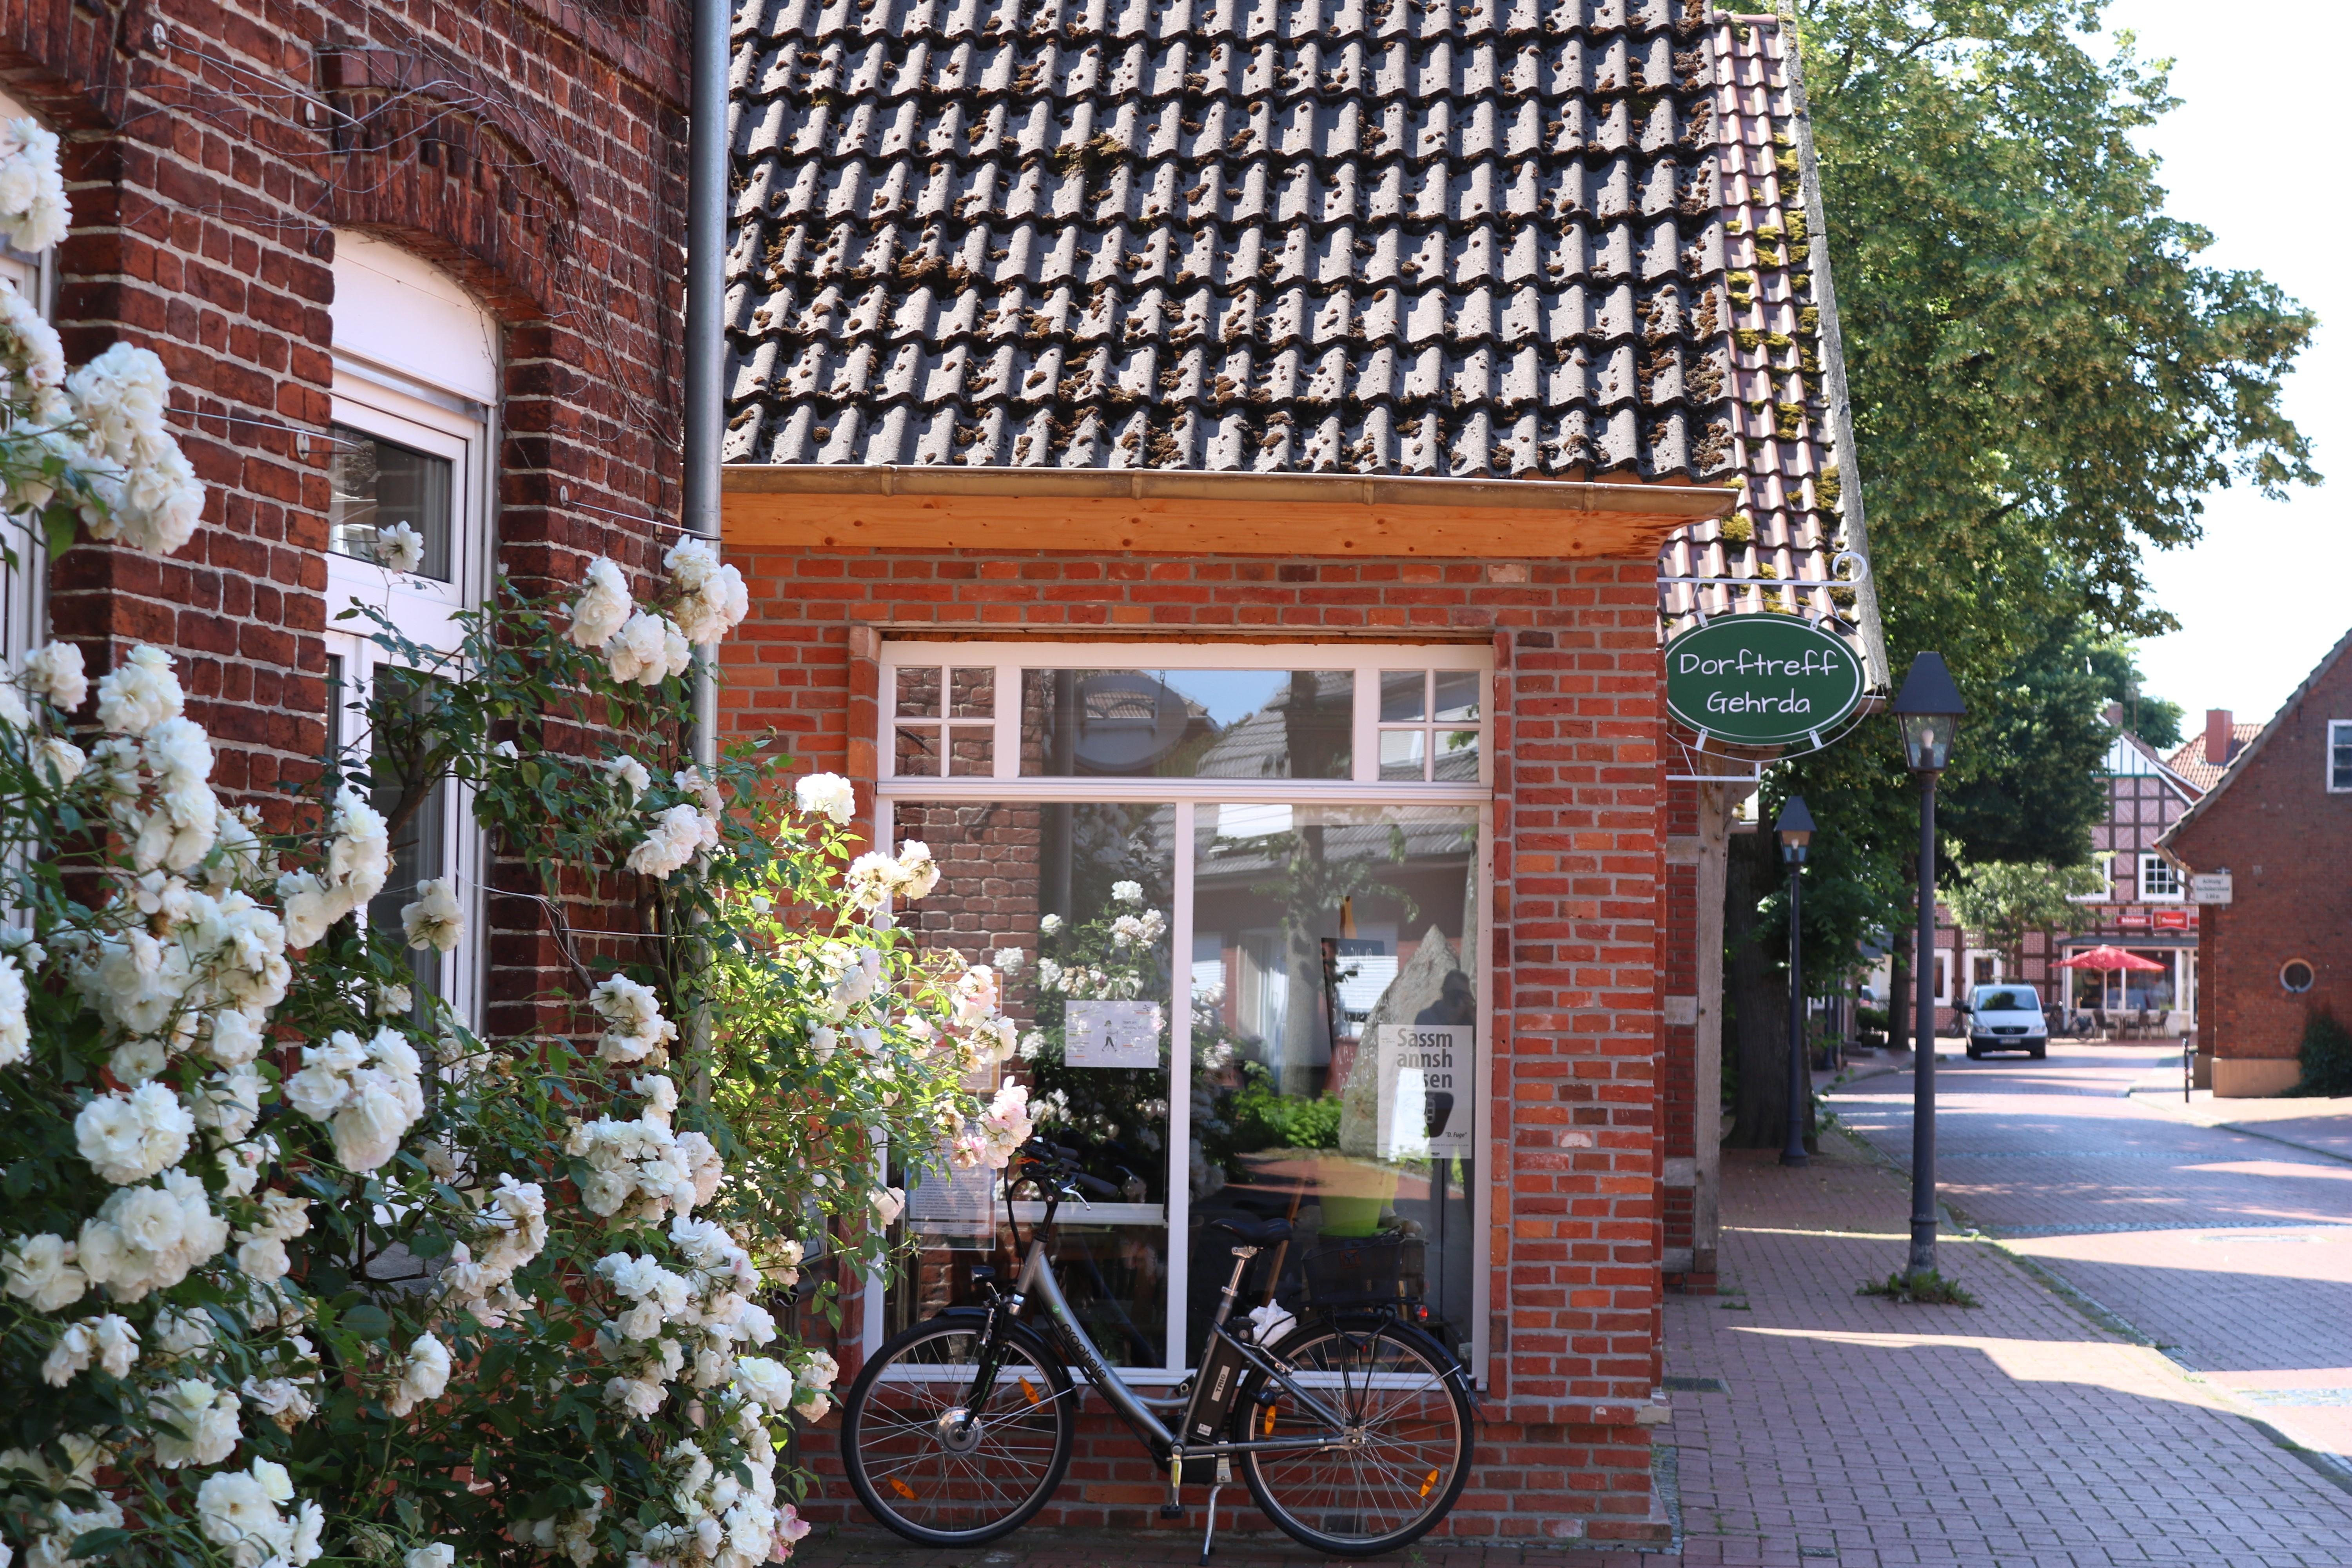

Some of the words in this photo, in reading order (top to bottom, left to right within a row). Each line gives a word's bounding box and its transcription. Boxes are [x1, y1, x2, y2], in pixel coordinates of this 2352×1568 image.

[1680, 648, 1838, 675] Dorftreff
[1706, 688, 1810, 714] Gehrda
[1397, 1027, 1453, 1047] Sassm
[1397, 1049, 1453, 1067] annsh
[1060, 1324, 1107, 1379] prophete
[1216, 1374, 1226, 1392] TRIO
